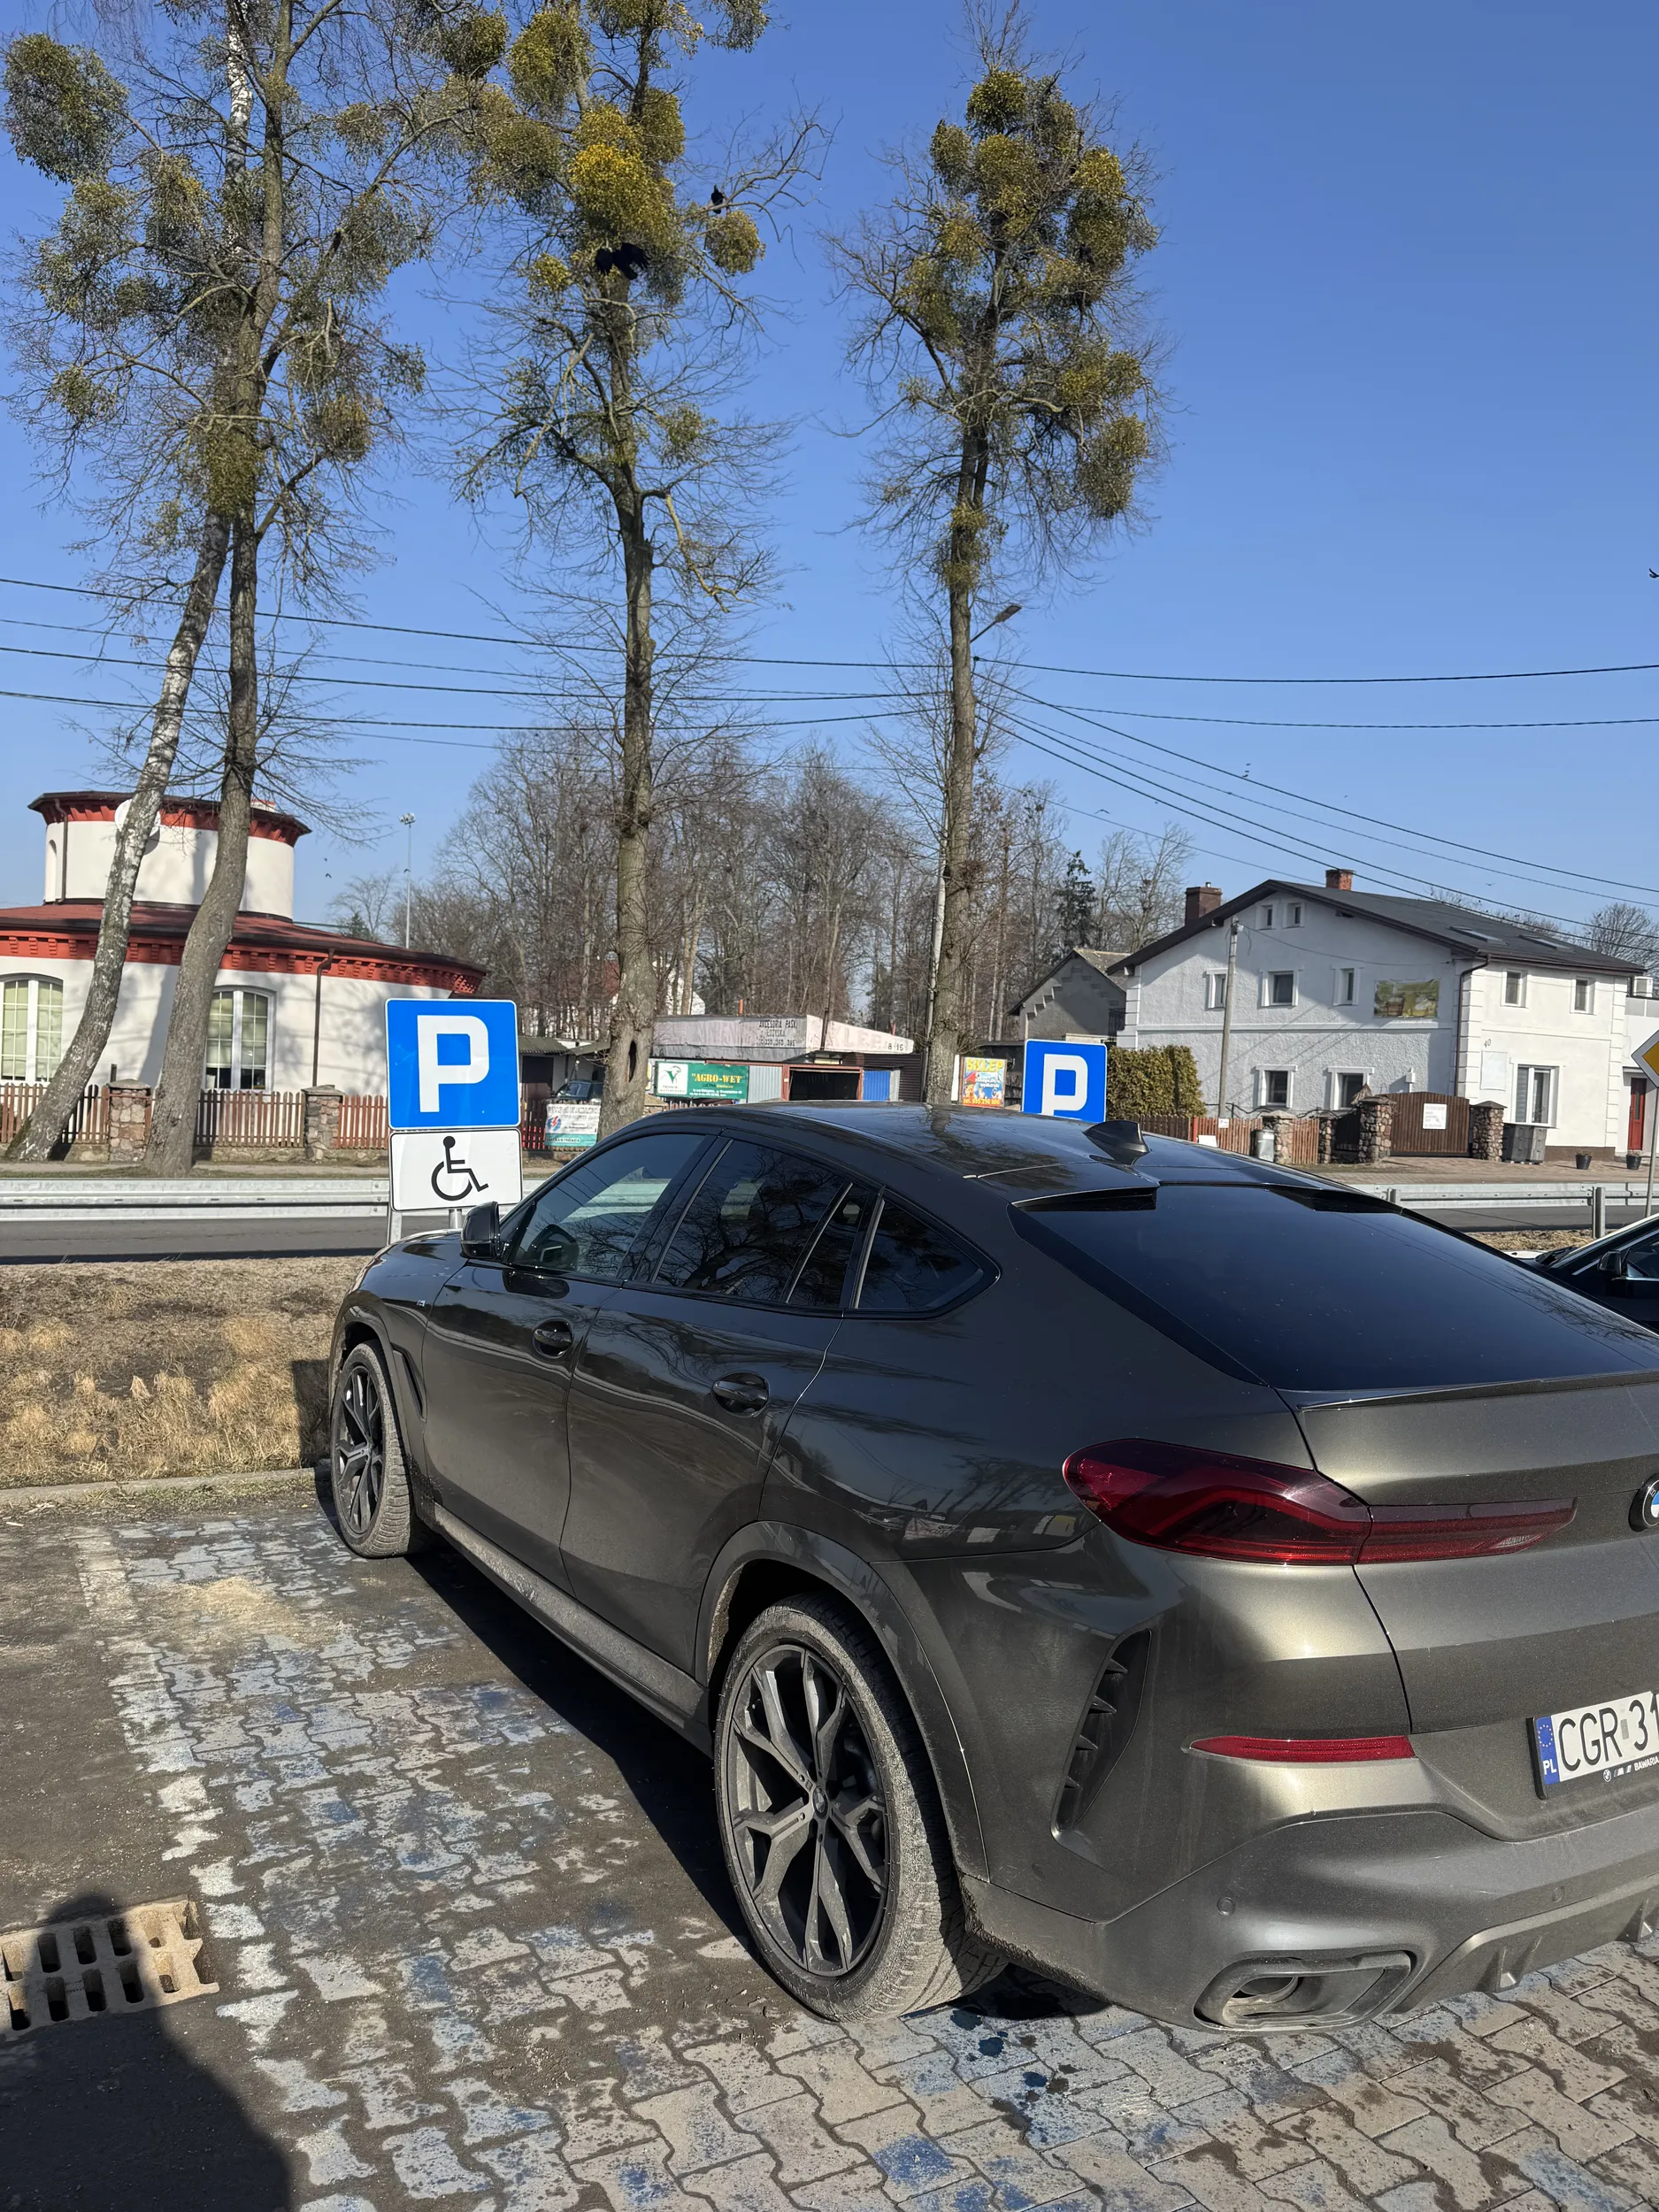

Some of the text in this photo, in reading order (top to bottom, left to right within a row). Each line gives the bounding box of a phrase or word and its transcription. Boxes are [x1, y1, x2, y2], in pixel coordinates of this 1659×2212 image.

[418, 1015, 489, 1112] P
[967, 1058, 1003, 1072] SKLEP
[1041, 1053, 1088, 1116] P
[1542, 1758, 1557, 1775] PL
[1558, 1707, 1623, 1771] CGR
